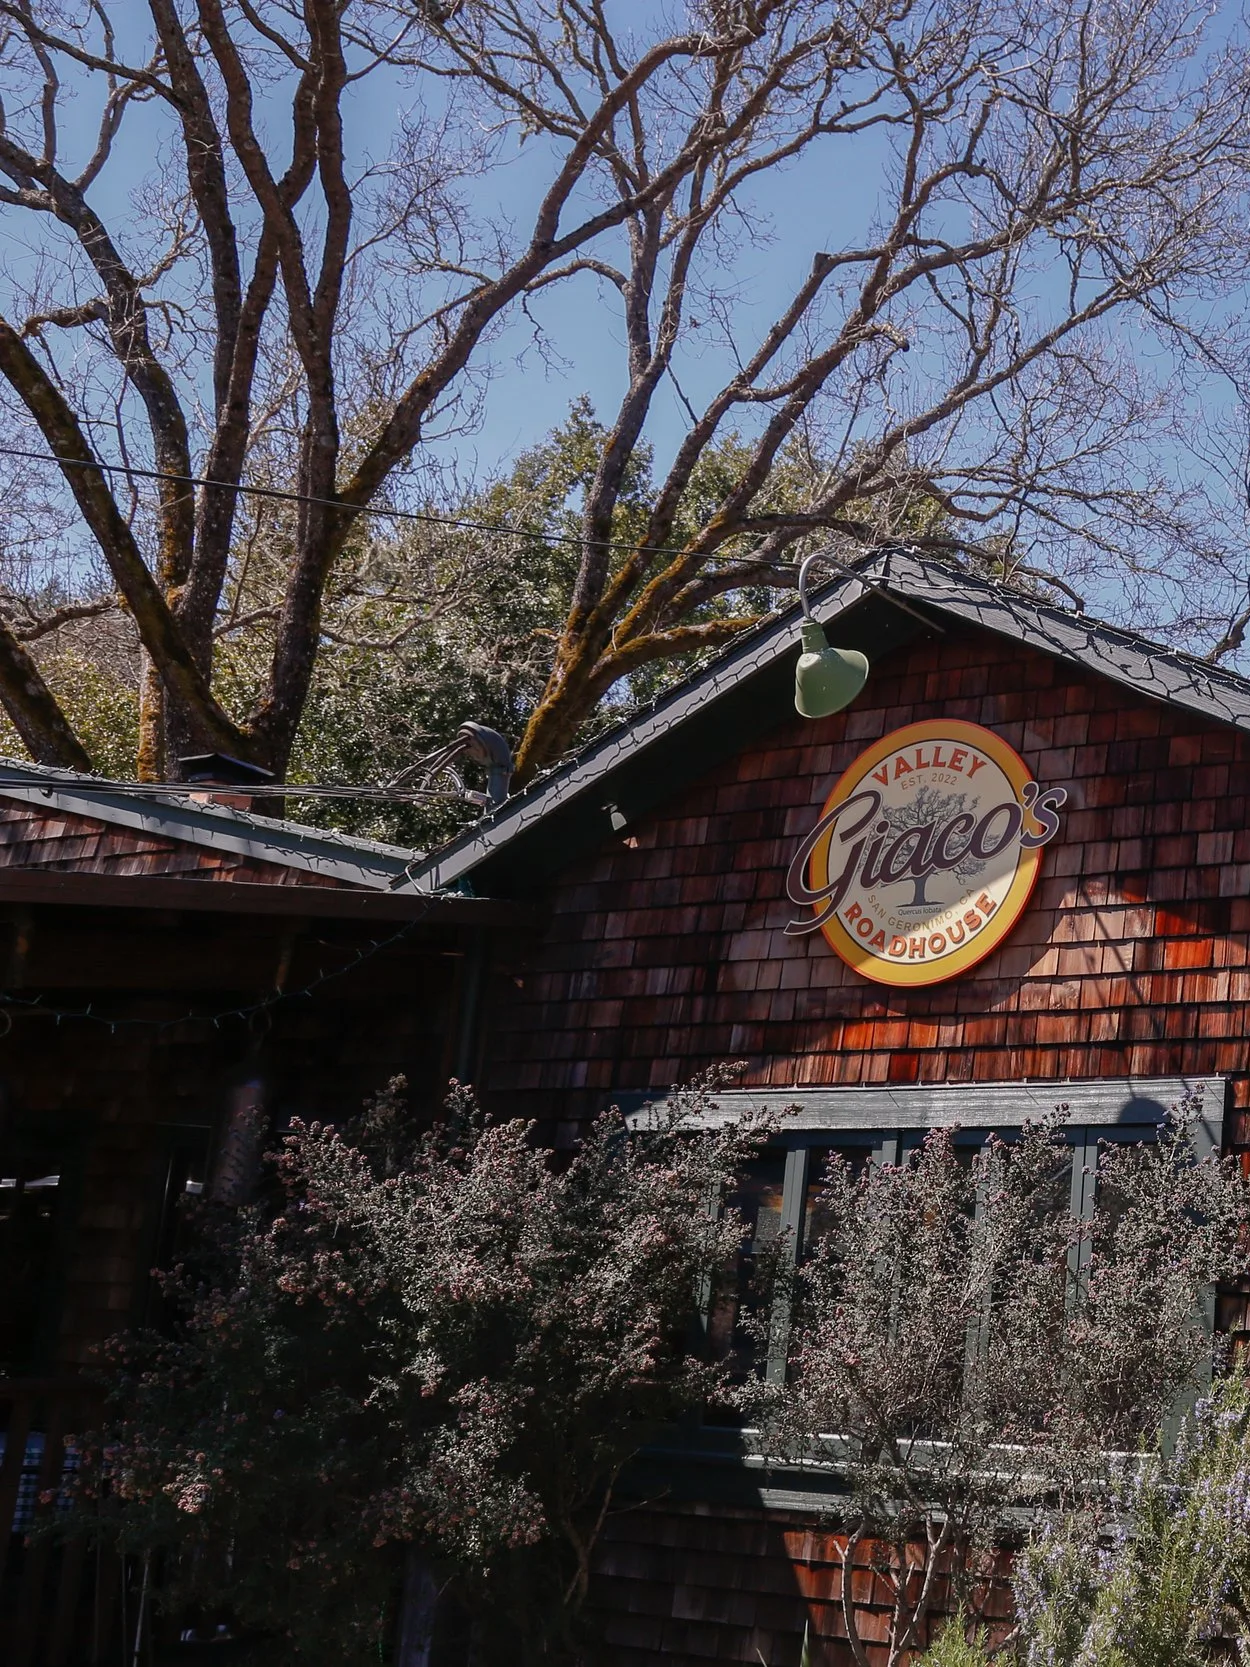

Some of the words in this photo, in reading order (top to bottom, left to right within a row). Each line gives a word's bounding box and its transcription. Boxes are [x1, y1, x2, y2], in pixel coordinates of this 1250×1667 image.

[871, 746, 987, 786] VALLEY
[901, 775, 926, 790] EST.
[931, 773, 957, 786] 2022
[783, 780, 1068, 936] Giaco's
[868, 895, 886, 918] SAN
[960, 889, 974, 905] CA
[843, 892, 997, 959] ROADHOUSE
